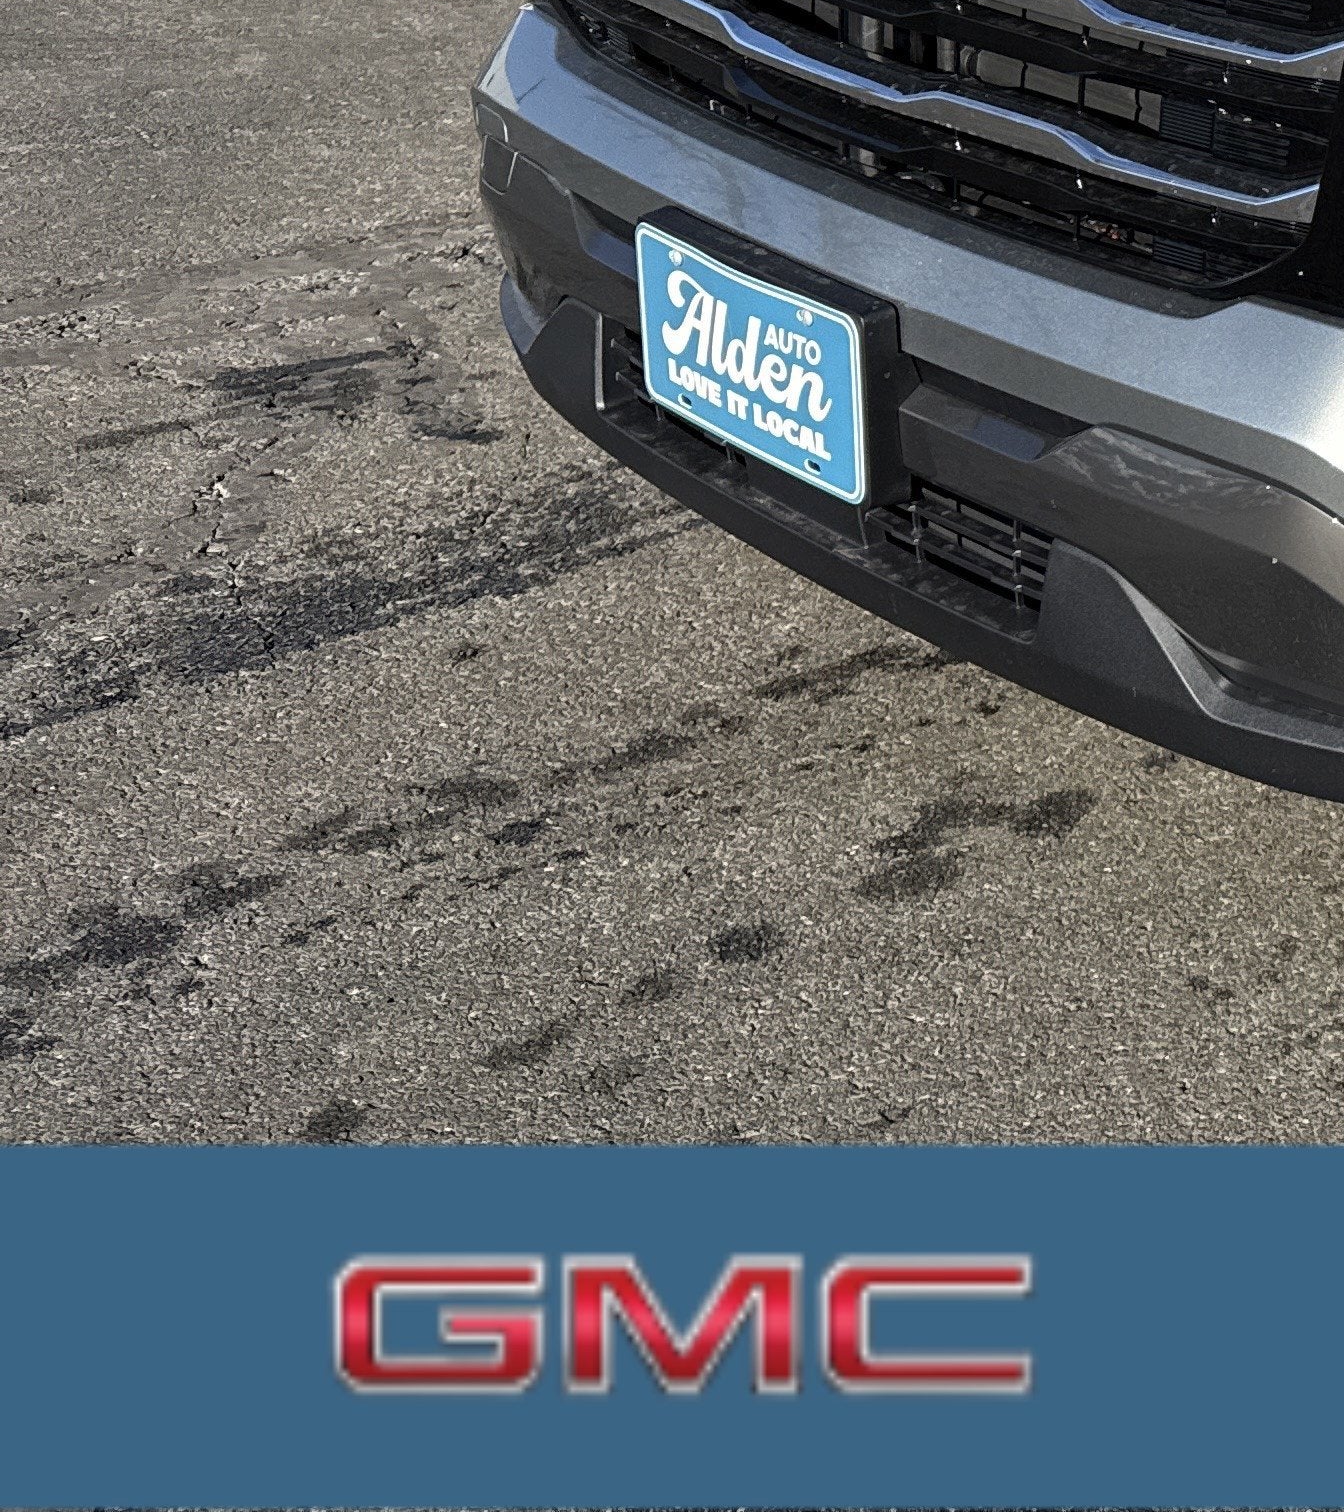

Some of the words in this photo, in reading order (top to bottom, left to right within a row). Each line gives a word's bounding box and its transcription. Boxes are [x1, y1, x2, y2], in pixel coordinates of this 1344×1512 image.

[660, 269, 833, 423] Alden
[763, 323, 822, 366] AUTO
[667, 357, 723, 407] LOVE
[727, 388, 751, 422] IT
[751, 403, 832, 462] LOCAL
